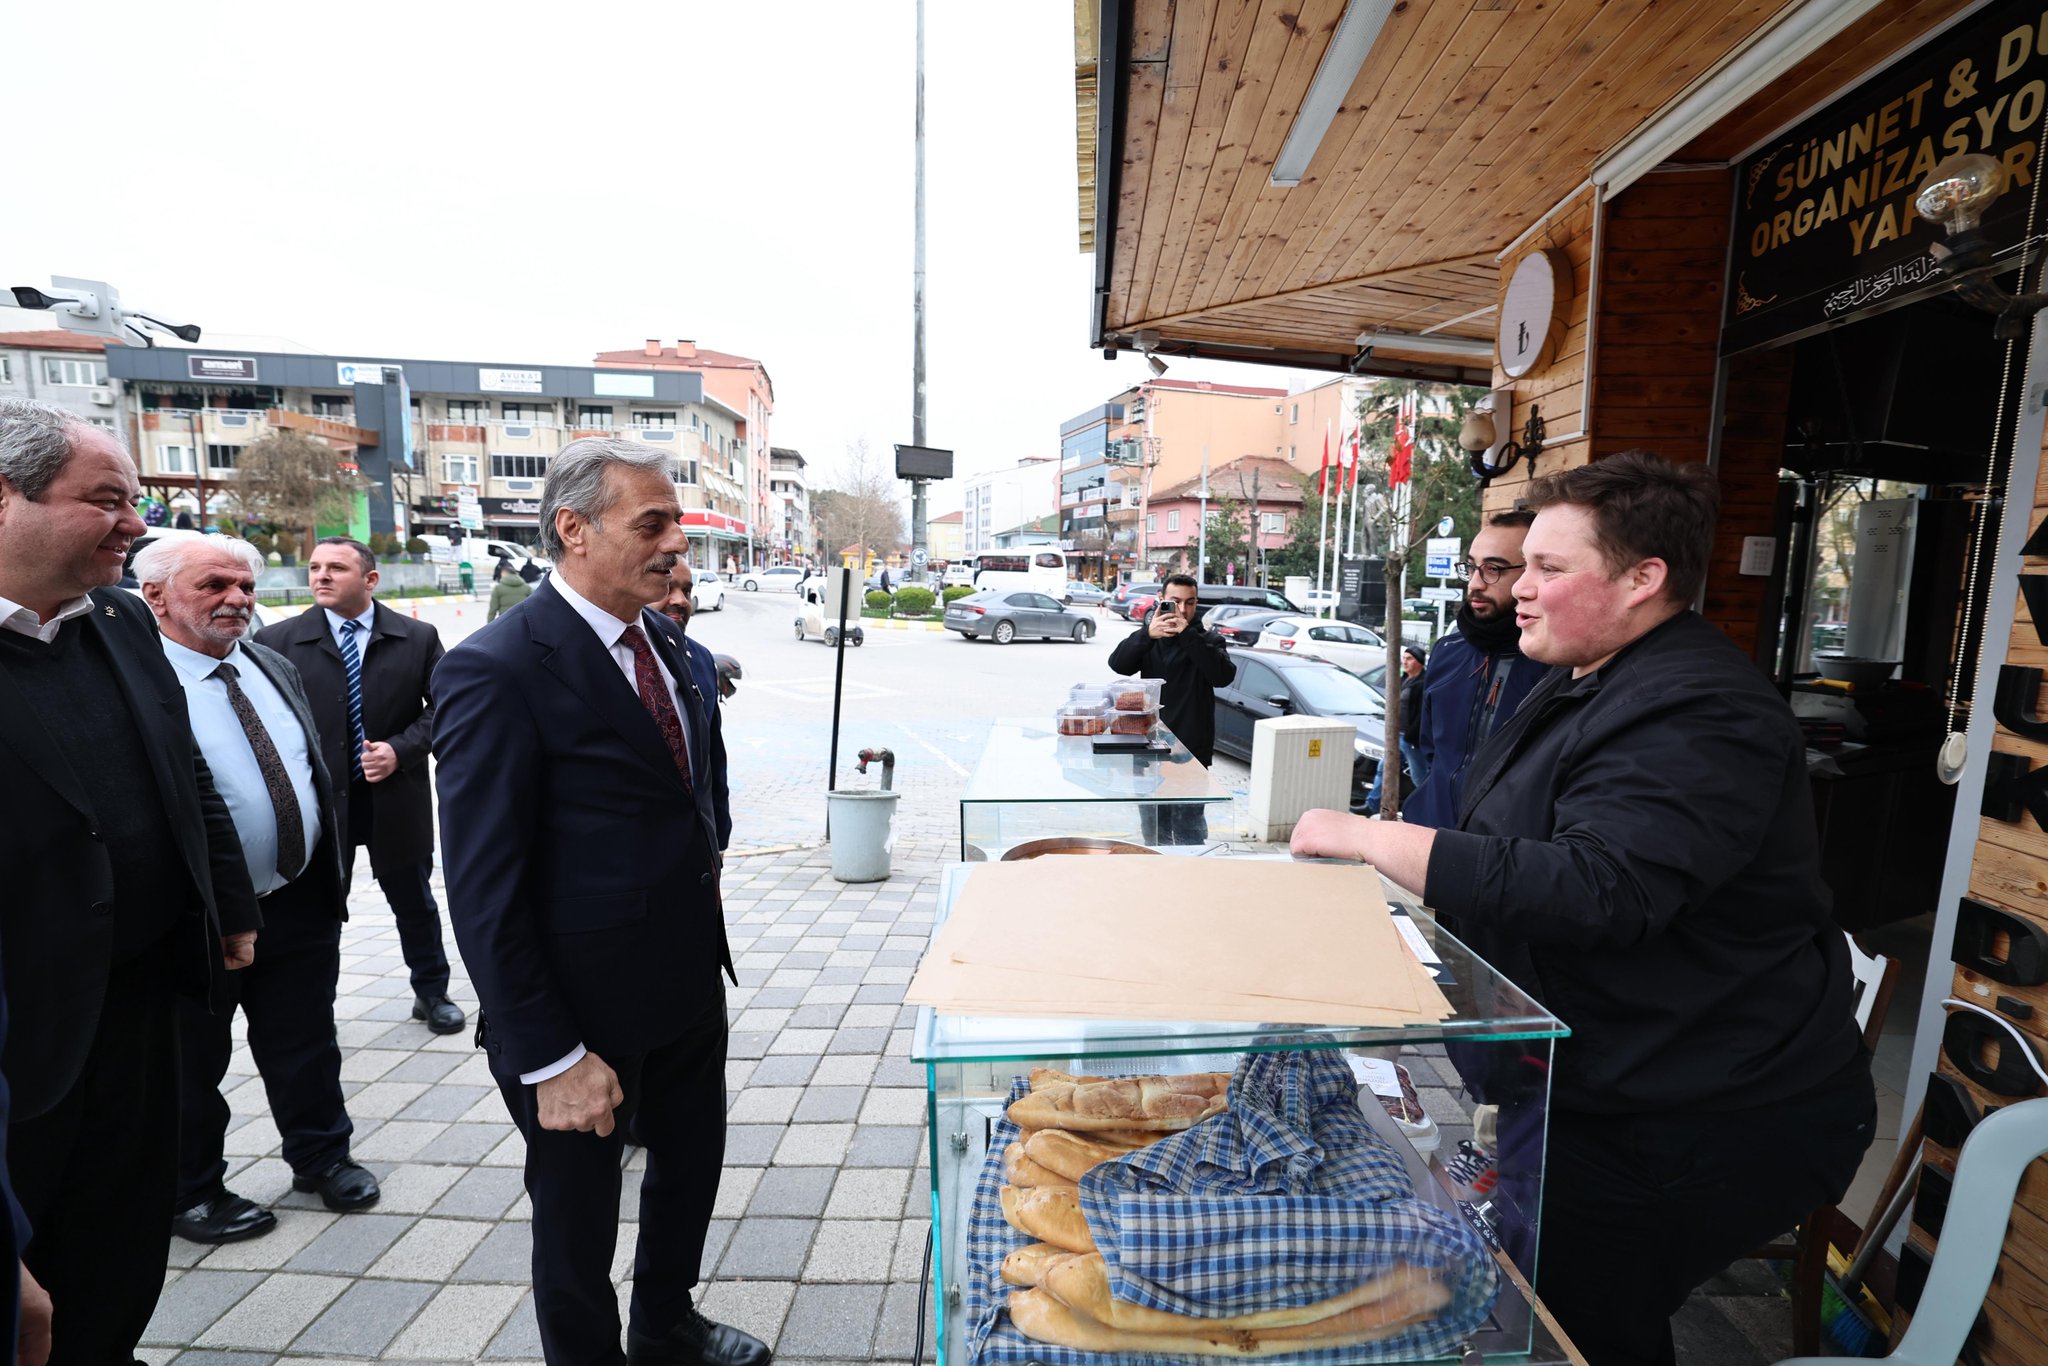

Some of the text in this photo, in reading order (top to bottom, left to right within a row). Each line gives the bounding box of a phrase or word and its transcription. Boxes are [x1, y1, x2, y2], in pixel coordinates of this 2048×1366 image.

[1775, 79, 1934, 202] SÜNNET
[1944, 58, 1980, 108] &
[500, 372, 539, 380] AVUKAT
